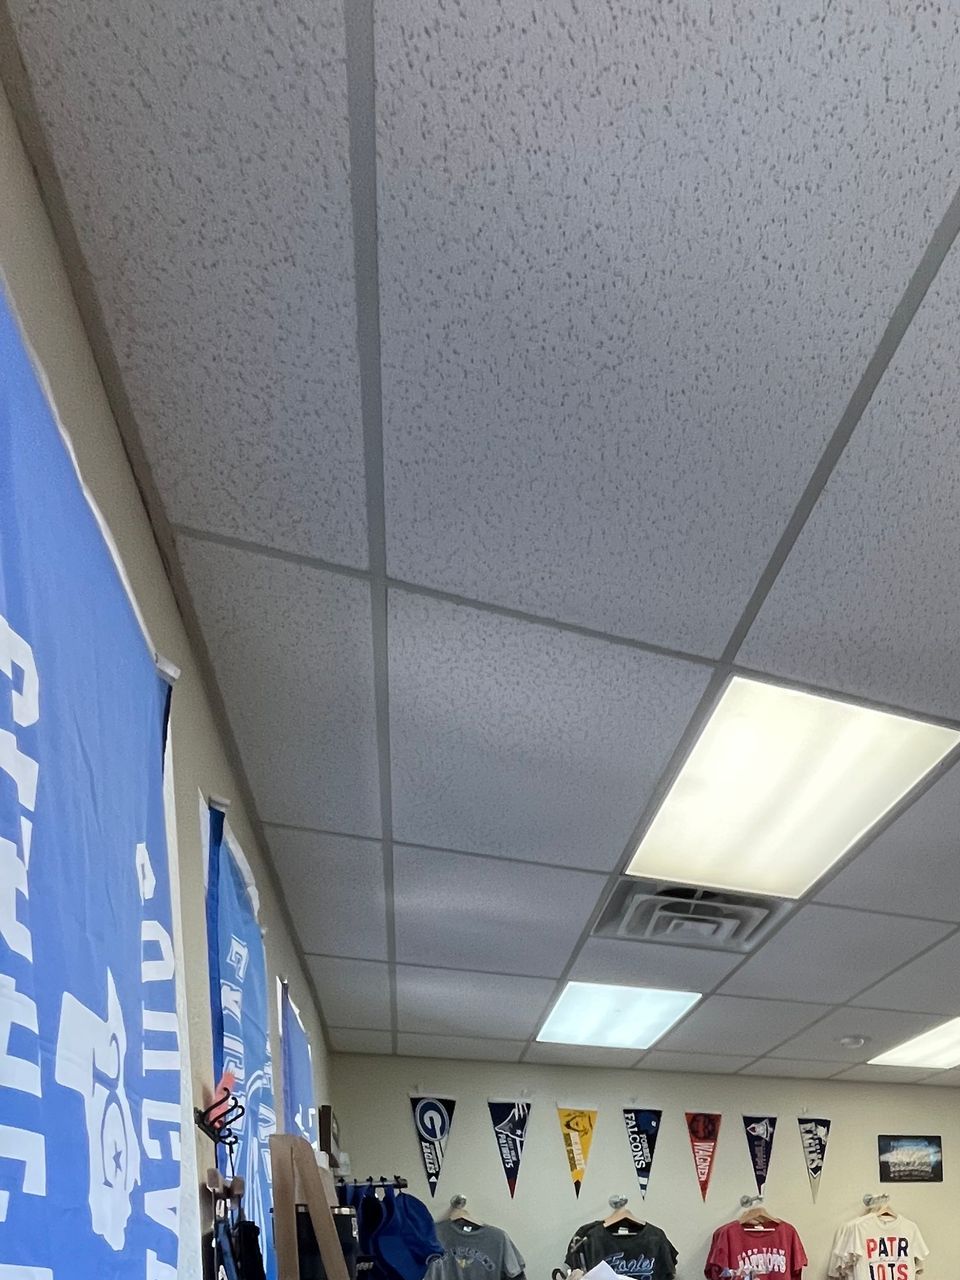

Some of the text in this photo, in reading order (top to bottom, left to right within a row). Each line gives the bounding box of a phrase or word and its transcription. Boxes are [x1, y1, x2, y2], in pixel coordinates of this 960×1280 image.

[624, 1112, 646, 1169] FALCONS
[694, 1142, 715, 1182] WAGNER
[865, 1236, 910, 1260] PATR
